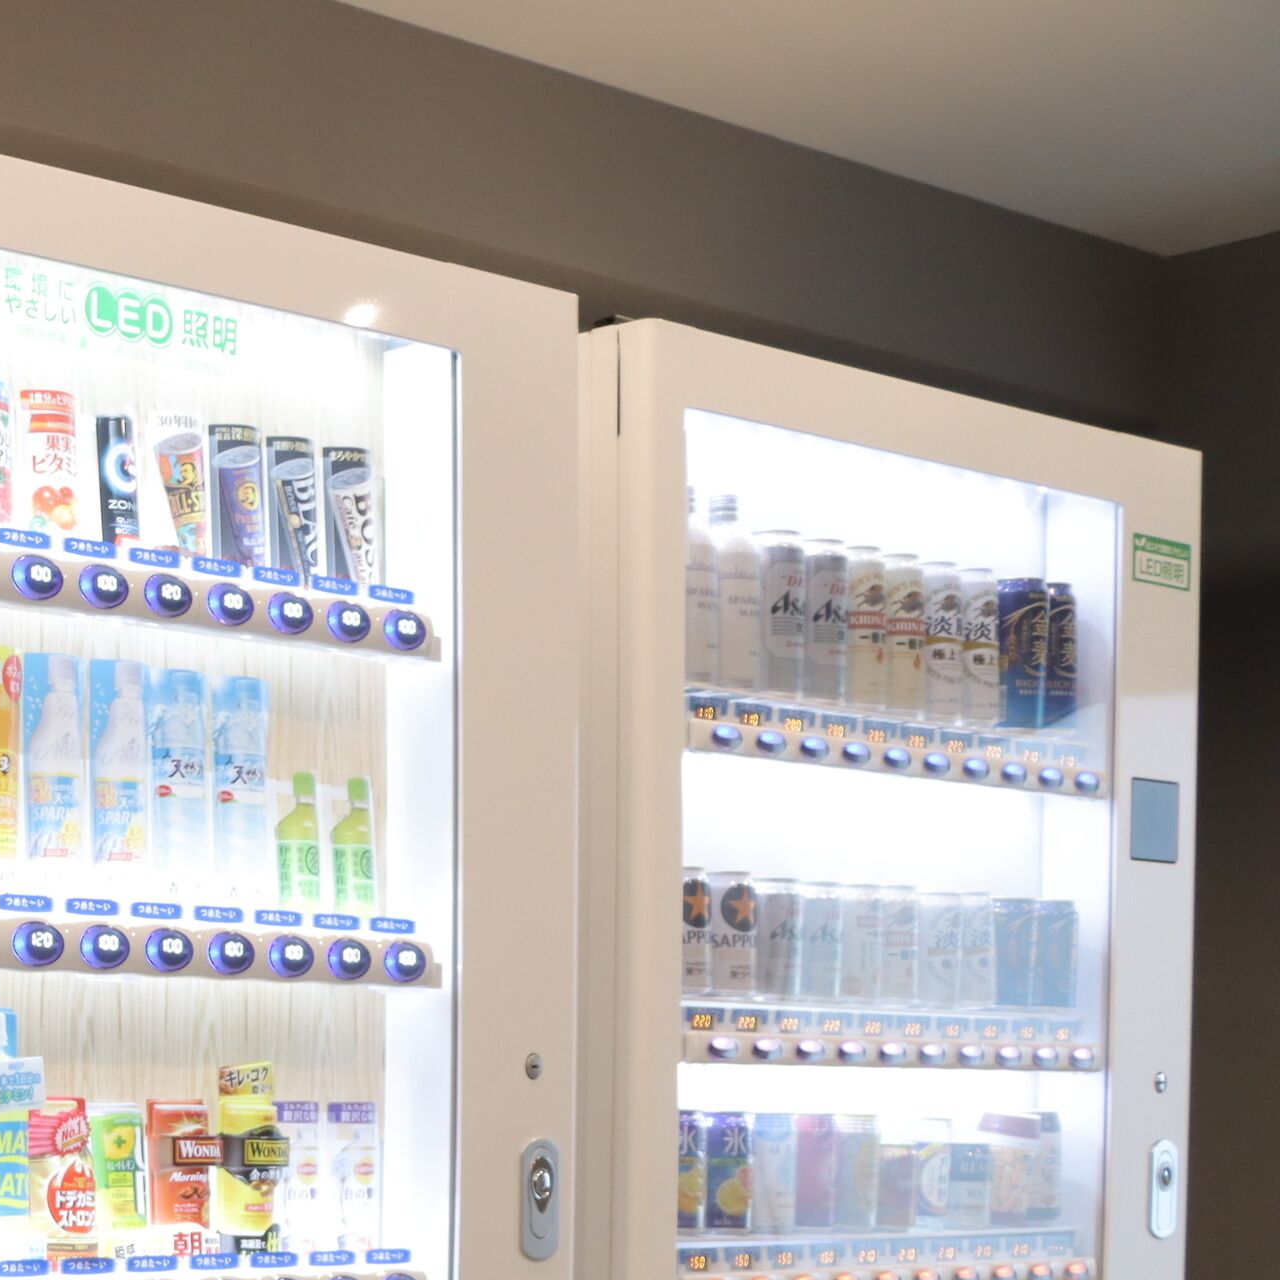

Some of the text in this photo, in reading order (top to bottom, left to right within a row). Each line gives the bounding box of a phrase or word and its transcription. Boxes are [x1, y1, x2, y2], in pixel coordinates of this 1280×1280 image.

[4, 265, 77, 301] 環境に
[4, 294, 77, 324] やさしい
[88, 289, 172, 341] LED
[181, 308, 238, 356] 照明
[2, 531, 44, 545] つめた〜い
[70, 539, 109, 554] つめた〜い
[135, 550, 173, 564] つめた〜い
[198, 560, 235, 573] つめた〜い
[259, 569, 294, 582] つめた〜い
[318, 579, 352, 592] つめた〜い
[375, 588, 407, 600] つめた〜い
[4, 896, 45, 908] つめた〜い
[72, 900, 112, 912] つめた〜い
[137, 904, 175, 917] つめた〜い
[200, 908, 237, 919] つめた〜い
[260, 911, 296, 923] つめた〜い
[320, 915, 353, 927] つめた〜い
[376, 920, 409, 930] つめた〜い
[32, 932, 52, 947] 120
[694, 1014, 711, 1027] 220
[739, 1016, 755, 1028] 220
[781, 1018, 798, 1030] 220
[824, 1020, 840, 1032] 220
[225, 1067, 269, 1089] キレ・コク
[61, 1122, 82, 1140] No.1
[173, 1231, 203, 1256] 朝
[196, 1256, 232, 1269] つめた〜い
[257, 1255, 291, 1264] つめた〜い
[315, 1253, 349, 1263] つめた〜い
[372, 1251, 404, 1261] つめた〜い
[691, 1256, 706, 1269] 150
[736, 1254, 749, 1267] 150
[1, 1263, 38, 1273] つめた〜い
[69, 1260, 106, 1270] つめた〜い
[134, 1258, 170, 1272] つめた〜い
